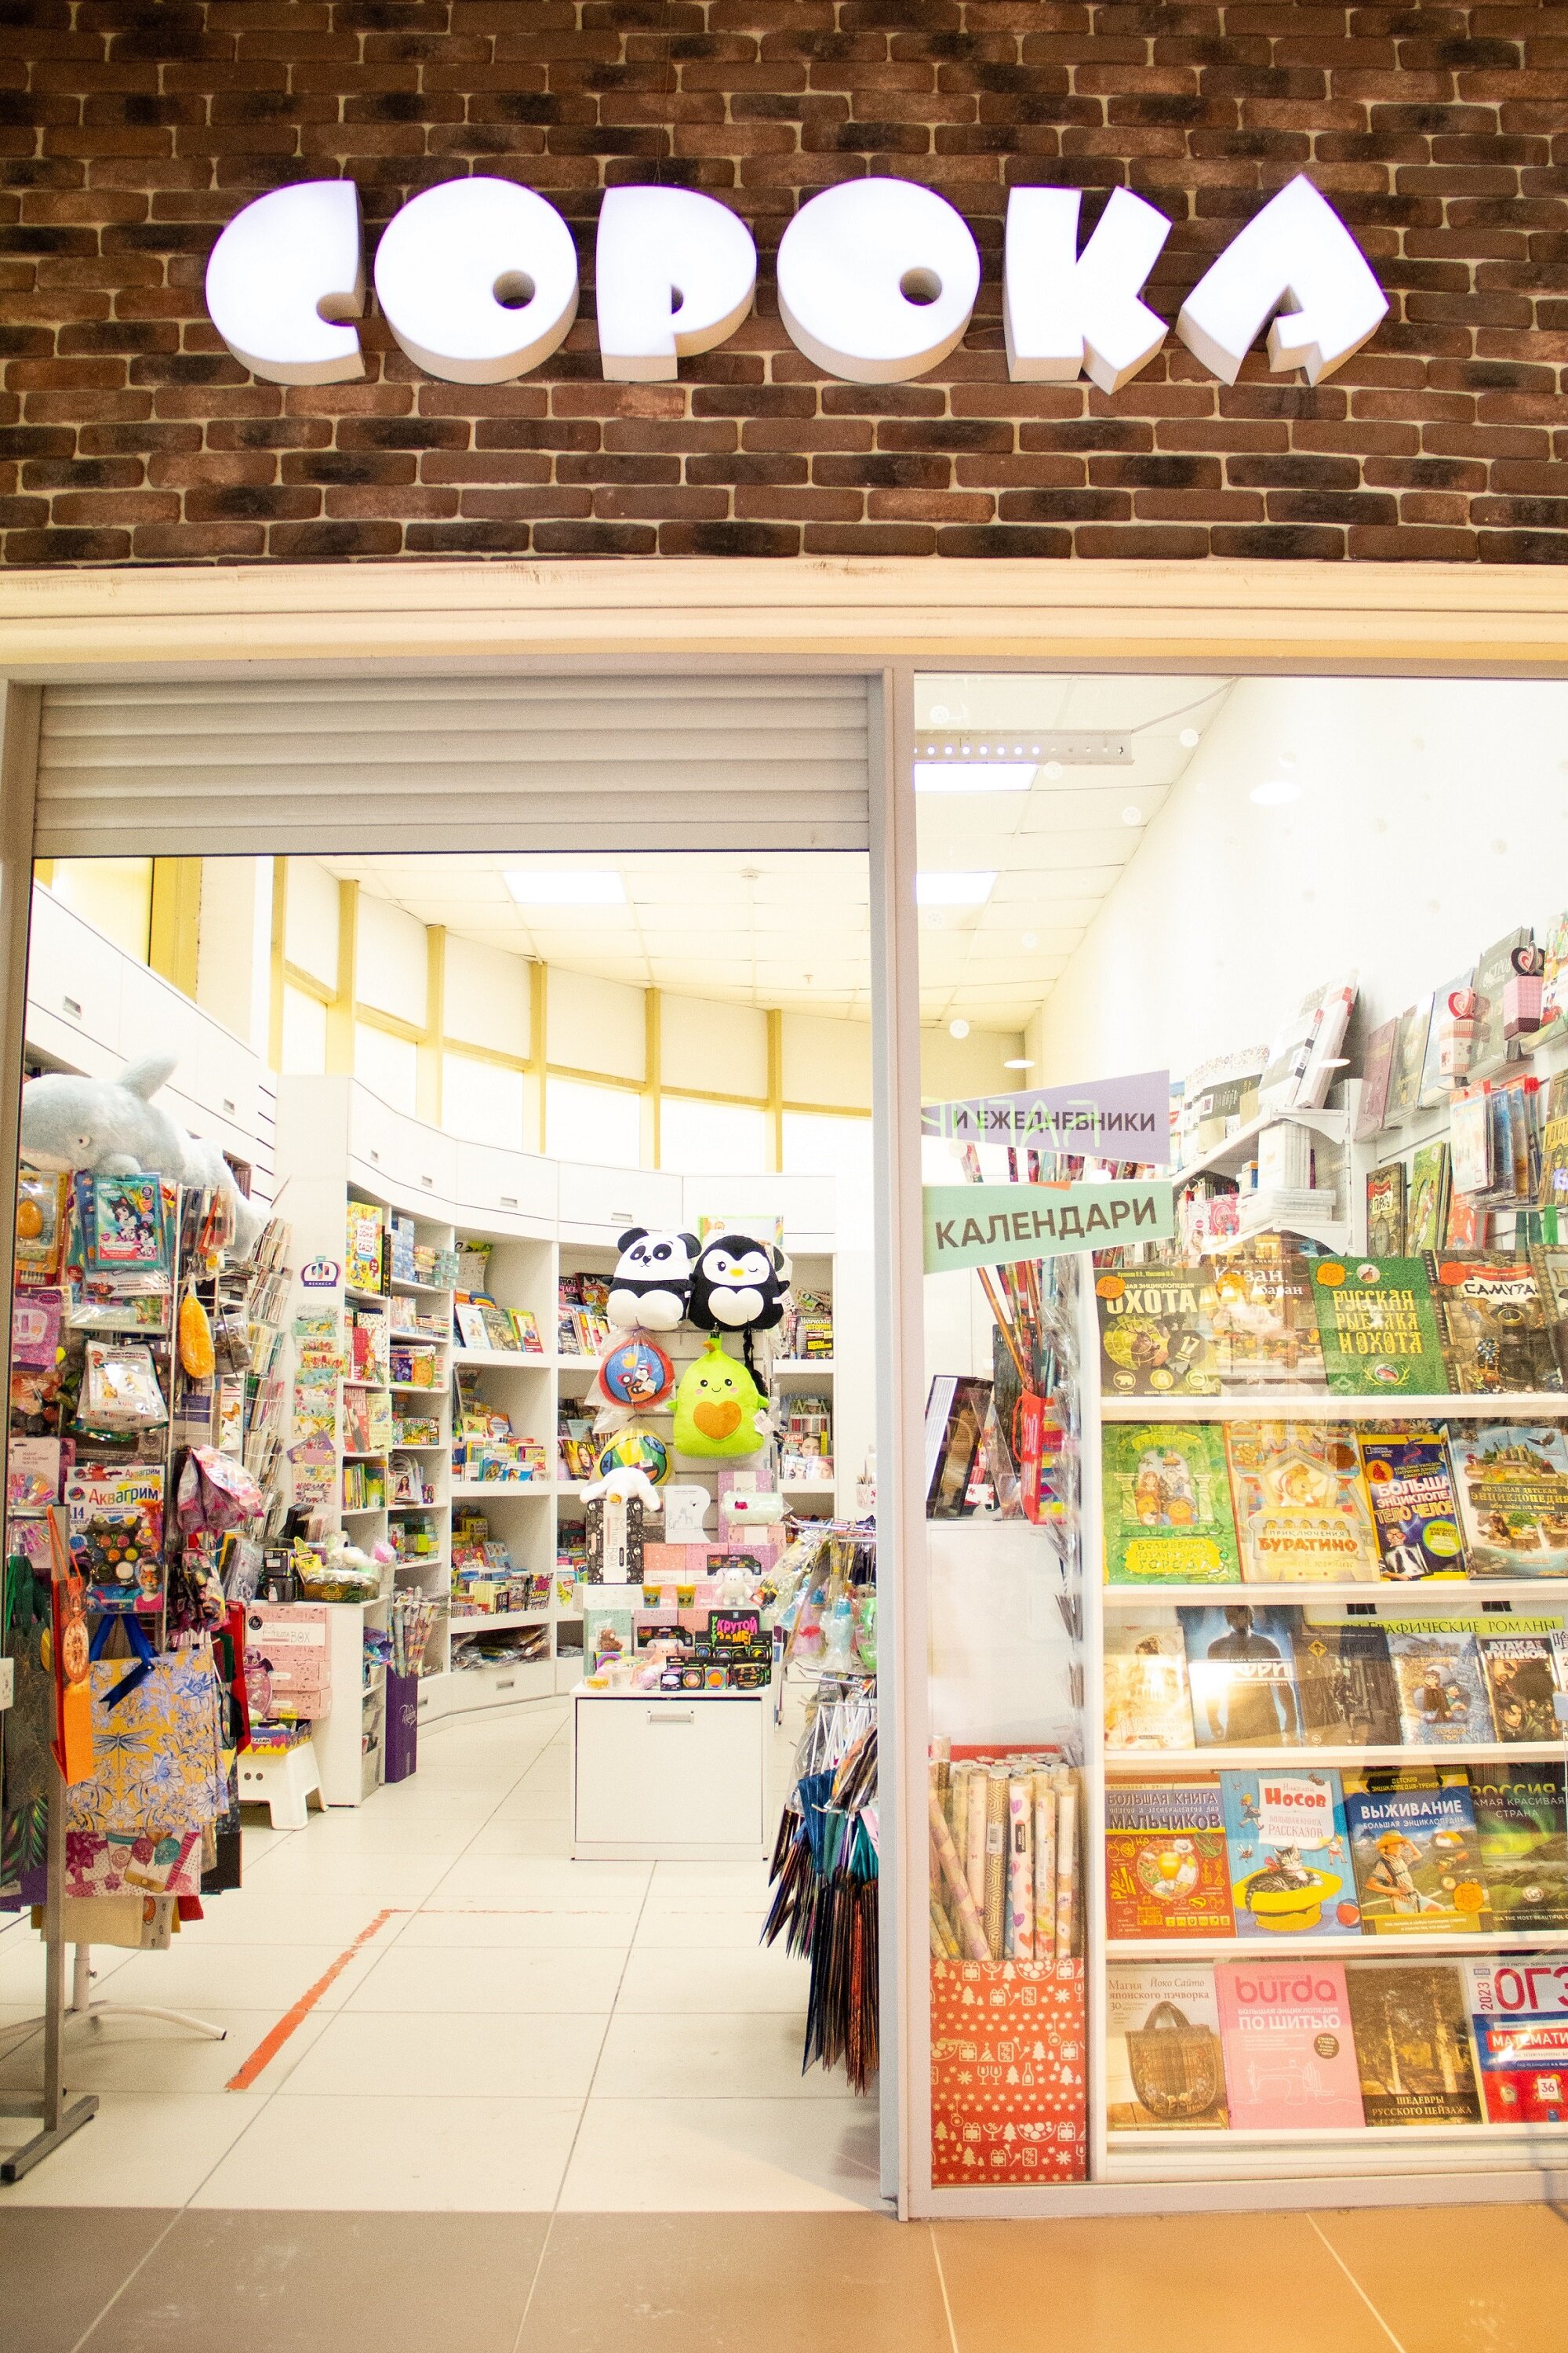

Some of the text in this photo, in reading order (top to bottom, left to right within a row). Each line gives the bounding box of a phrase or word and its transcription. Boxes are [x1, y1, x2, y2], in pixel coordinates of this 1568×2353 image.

[206, 174, 1389, 392] СОРОКА
[954, 1110, 1155, 1133] И ЕЖЕДНЕВНИКИ
[935, 1196, 1158, 1250] КАЛЕНДАРИ
[1332, 1289, 1416, 1311] РУССКАЯ
[1336, 1312, 1418, 1330] РЫБЛКА
[1355, 1331, 1424, 1355] ОХОТА
[1377, 1475, 1450, 1497] БОЛЬША
[89, 1487, 158, 1506] Аквагрим
[1377, 1490, 1451, 1508] ЭНЦИКЛОПЕ
[72, 1507, 85, 1519] 14
[1374, 1506, 1412, 1524] ТЕЛО
[1257, 1537, 1358, 1553] БУРАТИНО
[717, 1616, 758, 1634] КРУТОЙ
[1488, 1620, 1556, 1632] РОМАНЫ
[1108, 1791, 1219, 1806] БОЛЬШАЯ КНИГА
[1473, 1796, 1565, 1807] АМАЯ КРАСИВАЯ
[1360, 1799, 1463, 1820] ВЫЖИВАНИЕ
[1496, 1809, 1541, 1819] СТРАНА
[1109, 1813, 1223, 1831] МАЛЬЧИКОВ
[1362, 1816, 1466, 1830] БОЛЬШАЯ ЭНЦИКЛОПЕДИЯ
[1268, 1824, 1324, 1838] РАССКАЗОВ
[1108, 1980, 1142, 1991] Магия
[1150, 1977, 1205, 1988] Йоко Сайто
[1235, 1974, 1337, 2003] burda
[1164, 1992, 1210, 2002] пэчворка
[1477, 1982, 1493, 2011] 2023
[1239, 2014, 1341, 2031] ПО ШИТЬЮ
[1541, 2082, 1555, 2093] 36
[1396, 2096, 1445, 2105] ШЕДЕВРЫ
[1371, 2104, 1472, 2116] РУССКОГО ПЕЙЗАЖА
